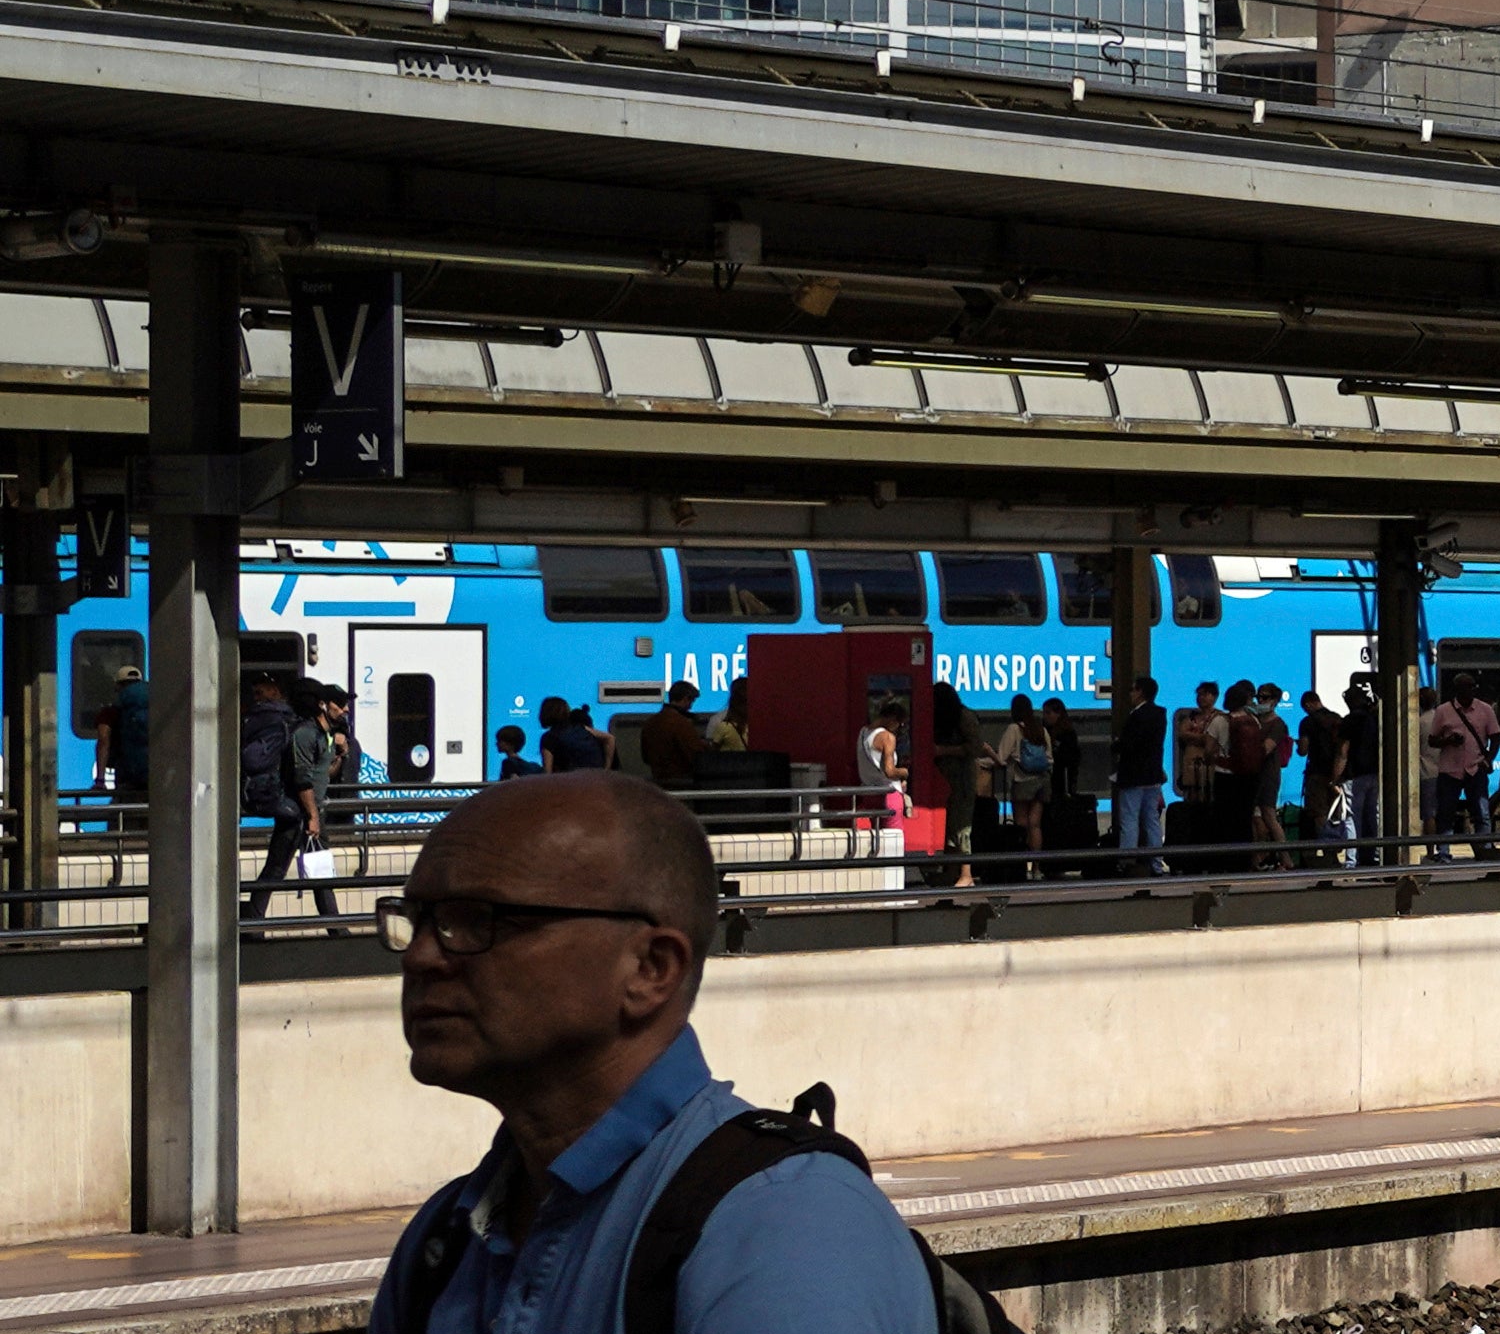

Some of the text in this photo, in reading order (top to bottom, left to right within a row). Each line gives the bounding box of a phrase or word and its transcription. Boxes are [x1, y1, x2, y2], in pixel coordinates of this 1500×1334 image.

[312, 303, 370, 397] V
[303, 423, 323, 435] Voie
[305, 439, 318, 467] J
[86, 509, 115, 557] V
[363, 666, 373, 684] 2
[937, 654, 1096, 692] RANSPORTE
